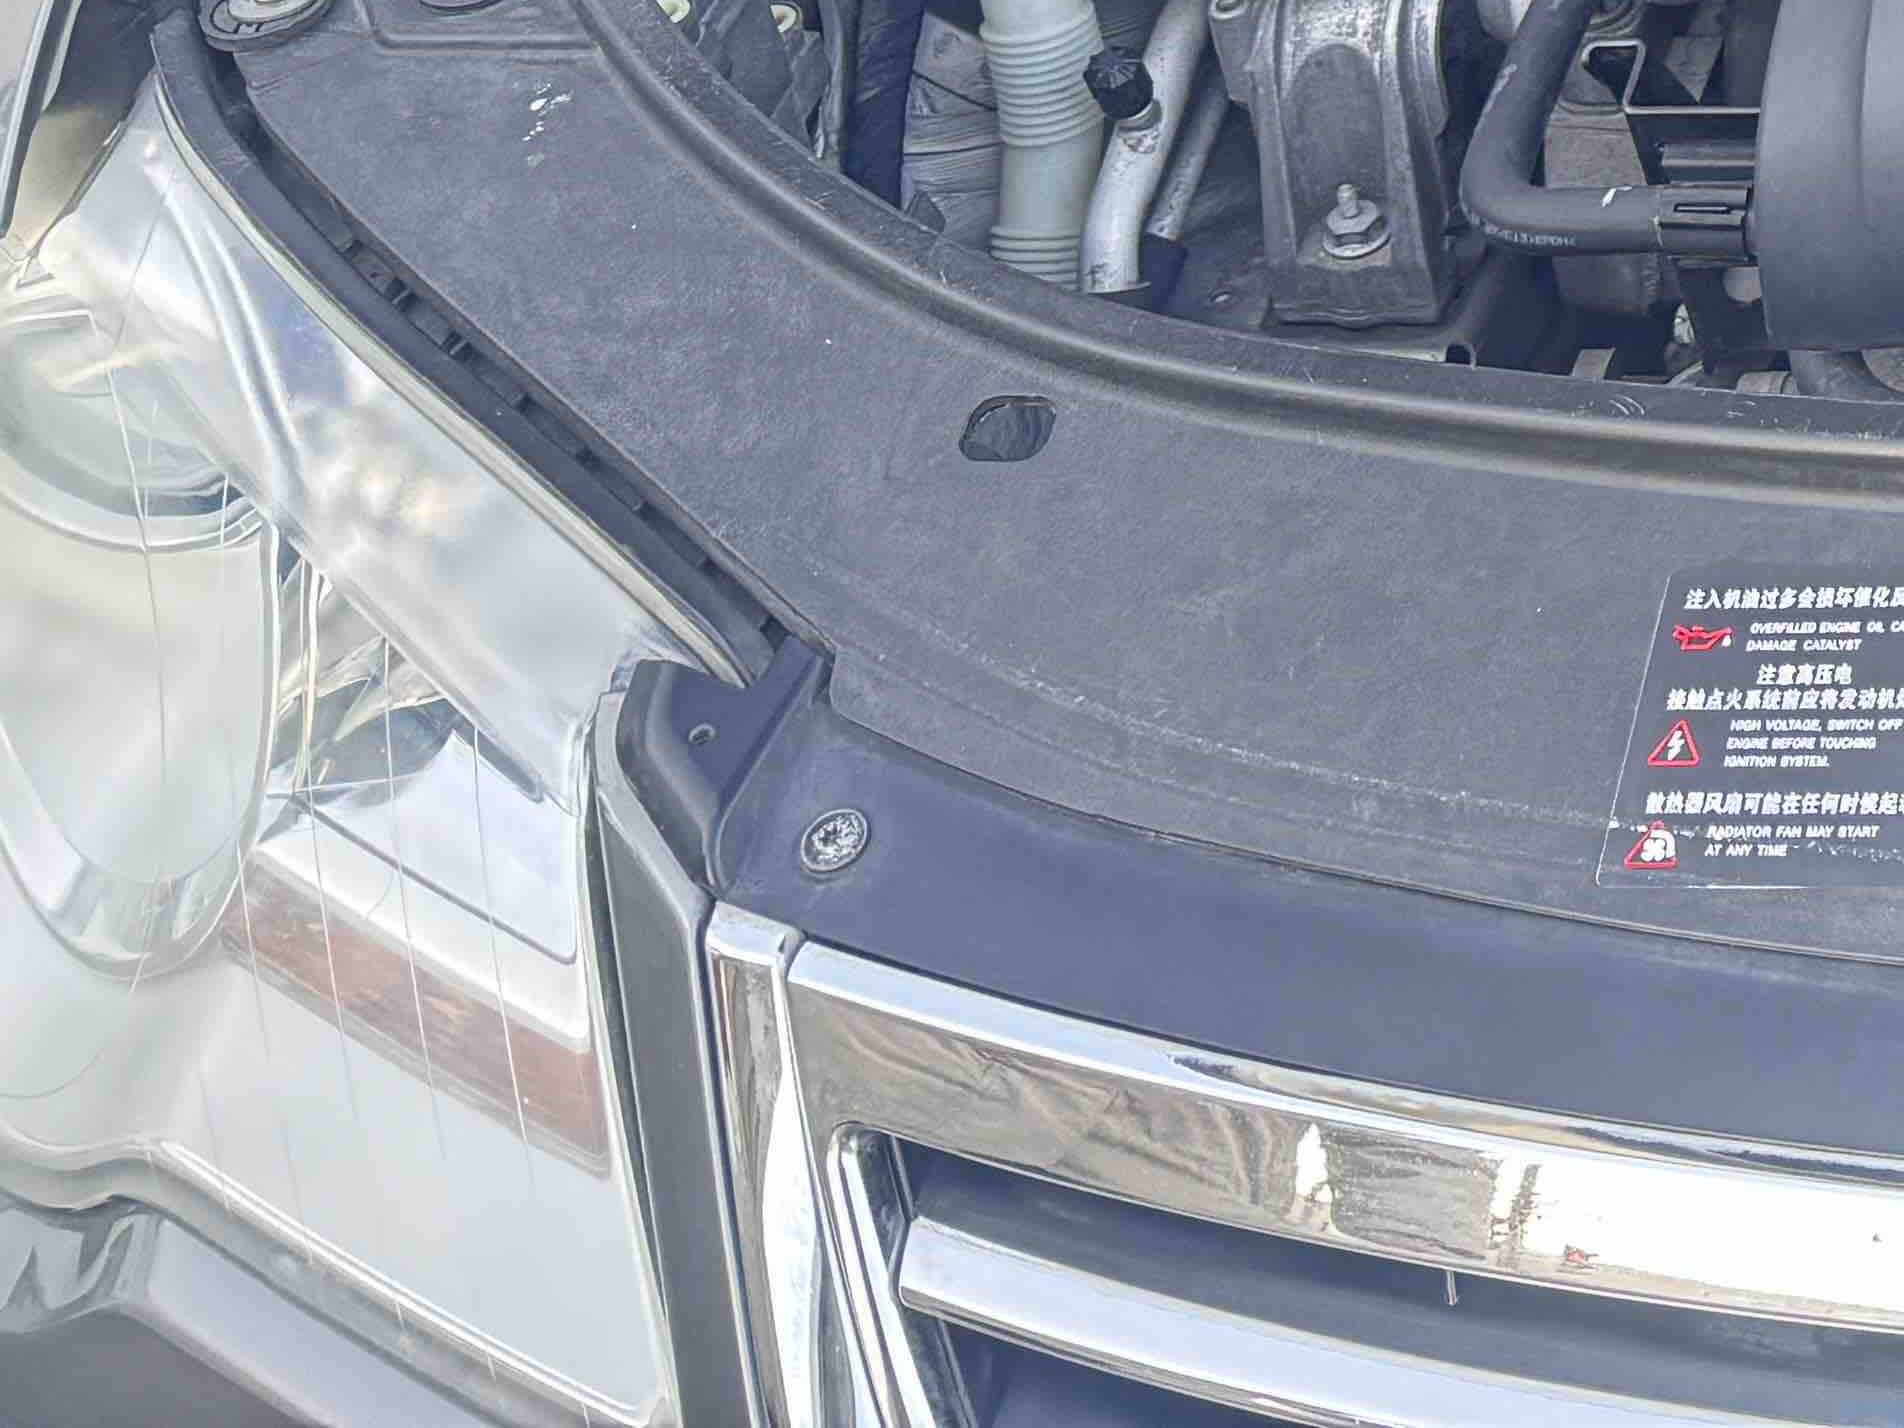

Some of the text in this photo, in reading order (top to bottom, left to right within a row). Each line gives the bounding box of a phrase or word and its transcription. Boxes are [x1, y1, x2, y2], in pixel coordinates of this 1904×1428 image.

[1750, 621, 1817, 634] OVERFILLED
[1819, 620, 1861, 634] ENGINE
[1746, 638, 1863, 652] DAMAGE CATALYST
[1756, 663, 1853, 685] 注意高压电
[1730, 718, 1762, 732] HIGH
[1877, 718, 1904, 731] OFF
[1771, 737, 1818, 750] BEFORE
[1819, 736, 1876, 750] TOUCHING
[1705, 824, 1881, 839] RADIATOR FAN MAY START
[1703, 843, 1788, 857] AT ANY TIME
